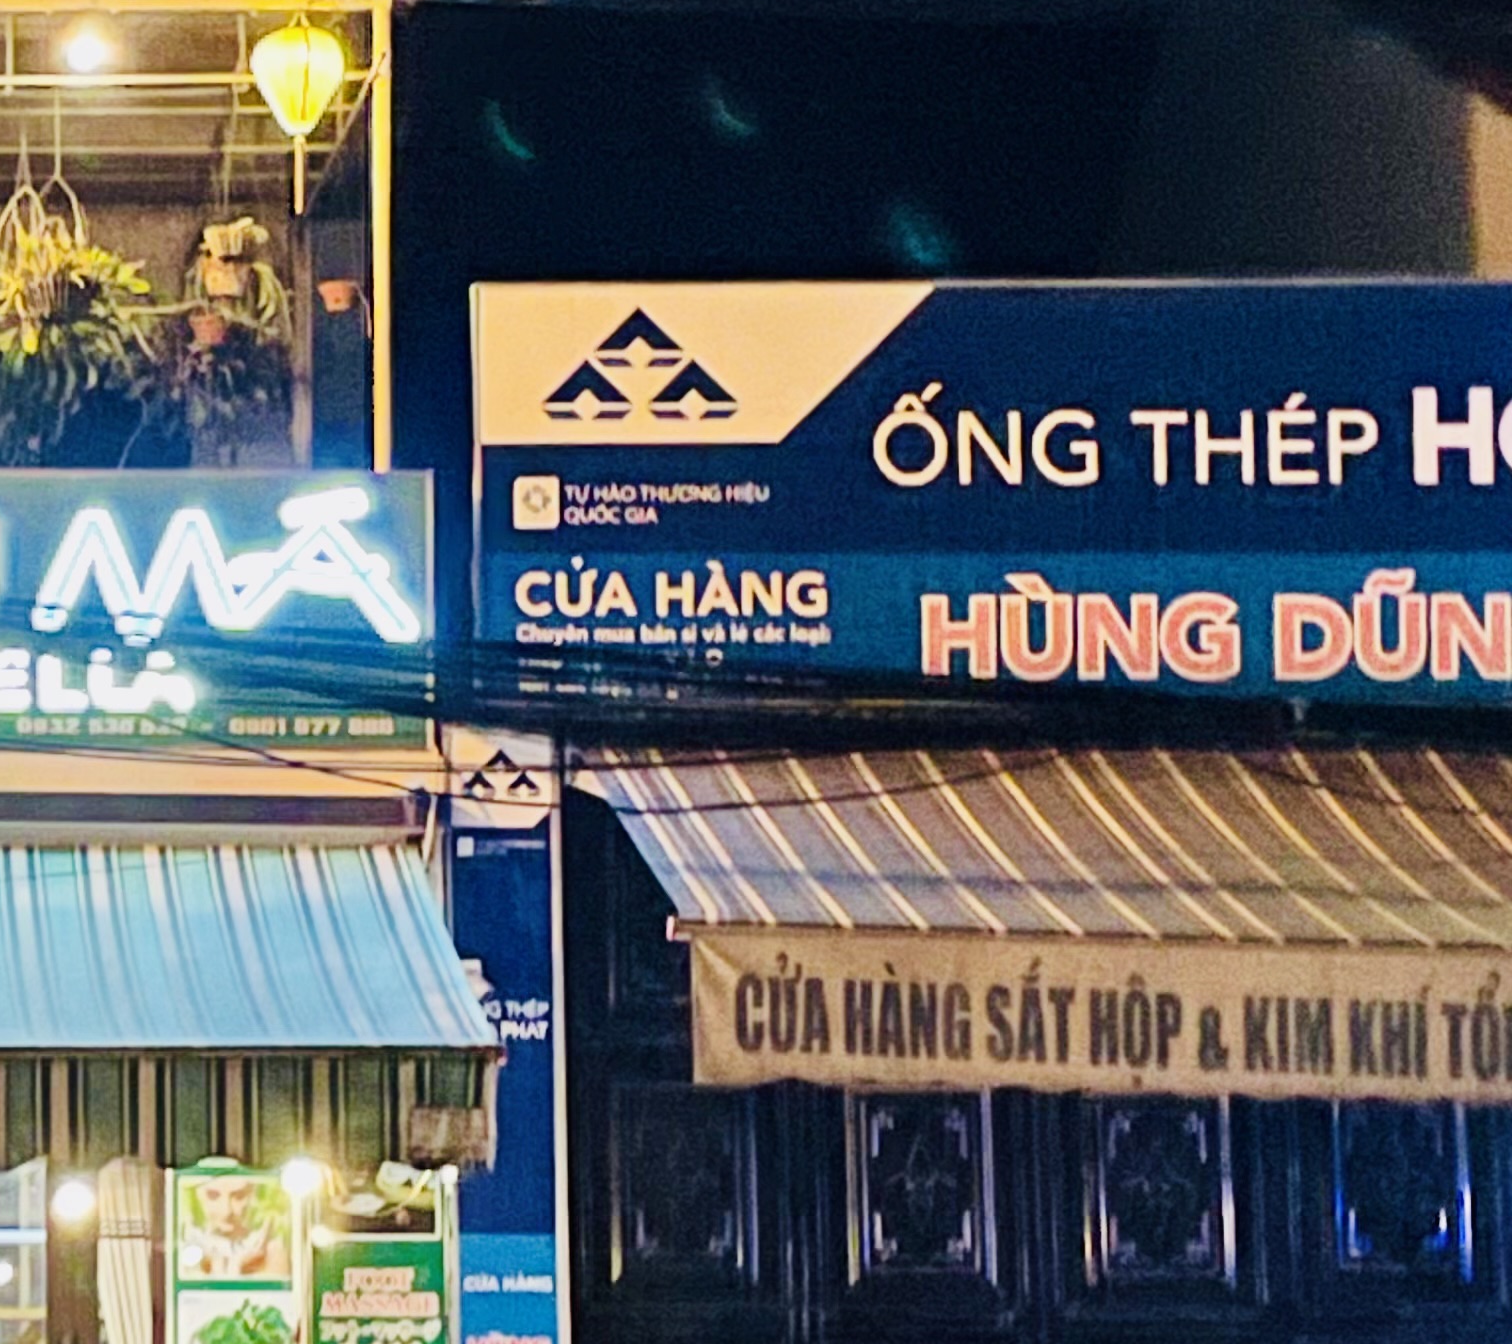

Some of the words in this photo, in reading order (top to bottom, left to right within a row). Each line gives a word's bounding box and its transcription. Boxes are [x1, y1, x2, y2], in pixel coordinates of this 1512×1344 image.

[873, 382, 1099, 487] ỐNG
[1129, 391, 1379, 487] THÉP
[1411, 385, 1512, 487] H
[624, 506, 659, 525] GIA
[514, 555, 638, 618] CỬA
[654, 559, 829, 618] HÀNG
[920, 572, 1241, 683] HÙNG
[734, 951, 831, 1054] CỬA
[843, 961, 972, 1061] HÀNG
[985, 956, 1076, 1064] SẮT
[1199, 1004, 1230, 1071] &
[1243, 994, 1334, 1076] KIM
[1349, 984, 1432, 1080] KHÍ
[1441, 970, 1512, 1081] TỔ
